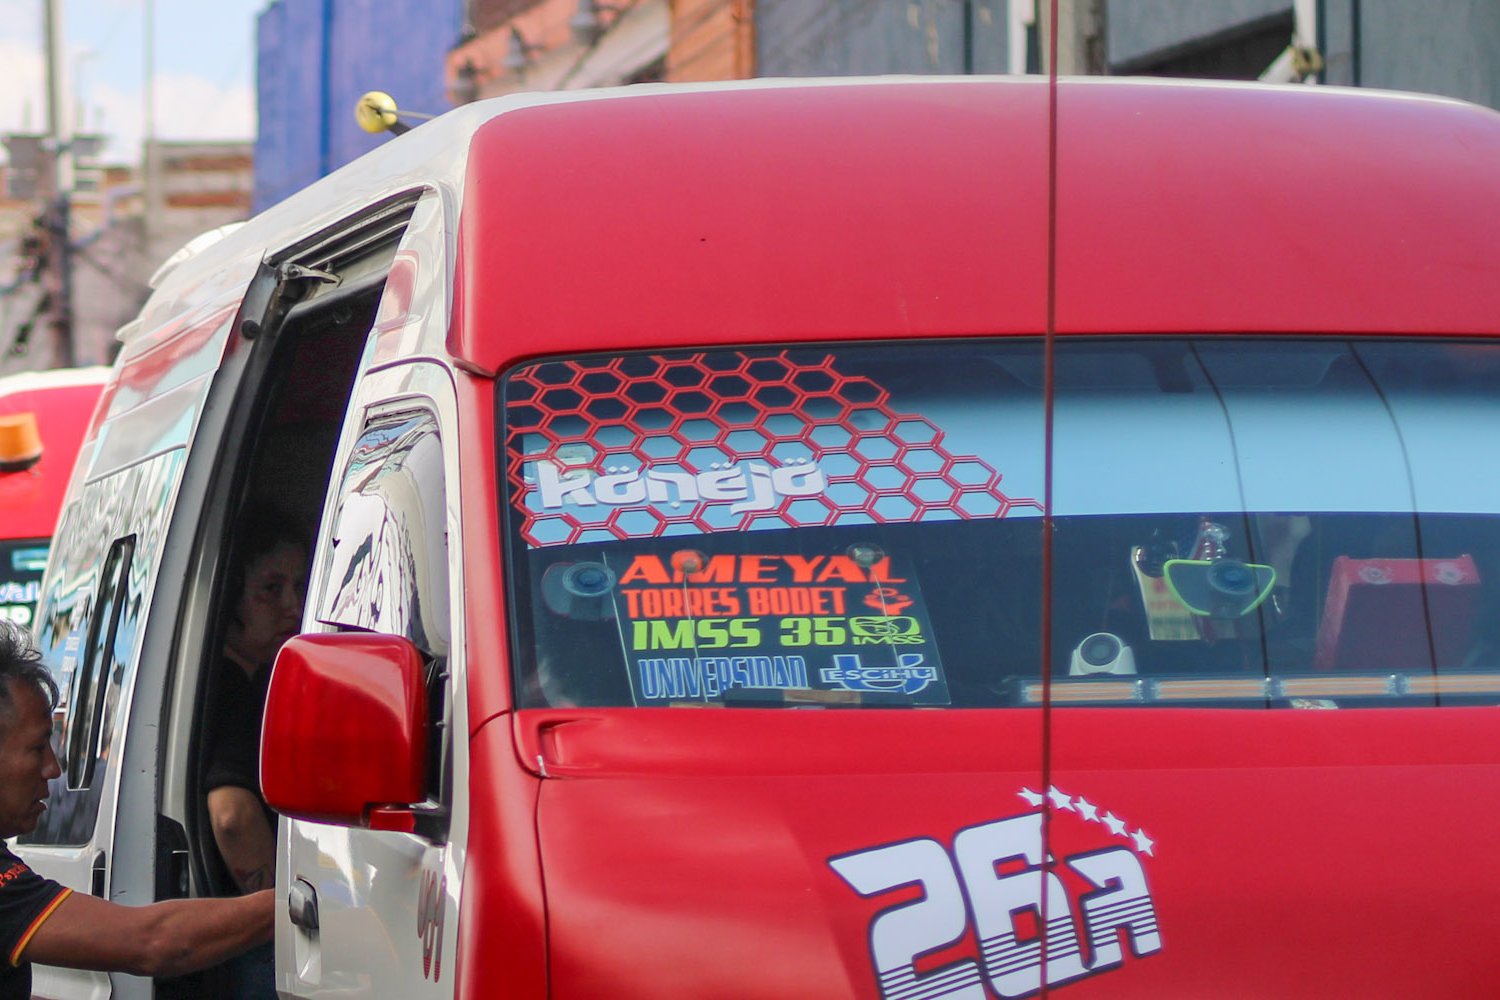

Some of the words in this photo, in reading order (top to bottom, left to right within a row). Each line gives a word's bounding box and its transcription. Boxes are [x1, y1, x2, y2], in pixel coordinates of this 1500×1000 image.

[619, 553, 907, 585] AMEYAL
[621, 587, 741, 619] TORRES
[746, 587, 847, 616] BODET
[632, 617, 761, 650] IMSS
[779, 617, 846, 647] 35
[637, 656, 813, 699] UNIVERSIDAD
